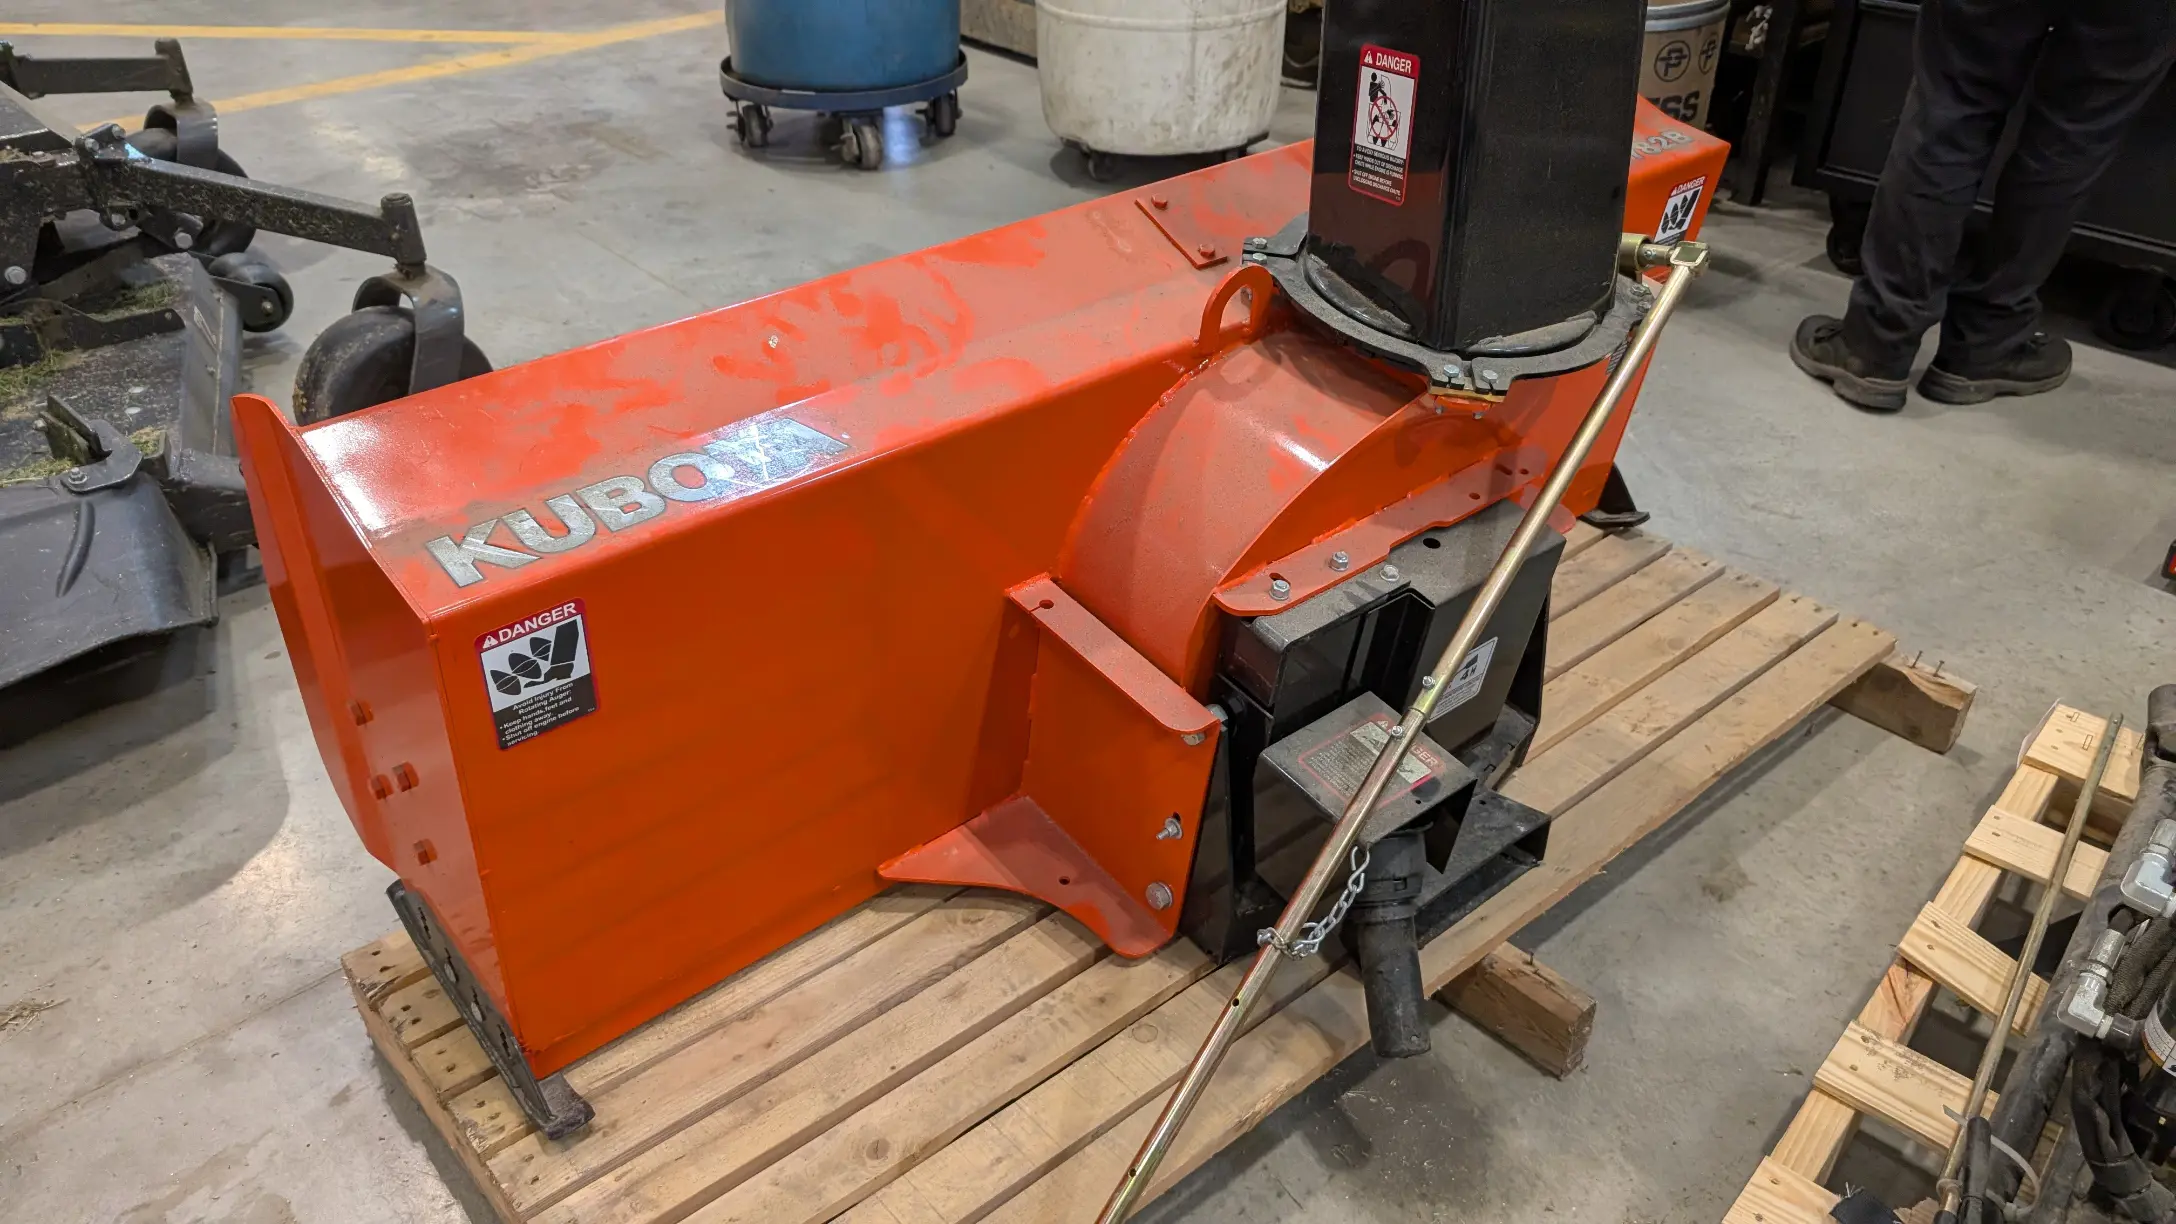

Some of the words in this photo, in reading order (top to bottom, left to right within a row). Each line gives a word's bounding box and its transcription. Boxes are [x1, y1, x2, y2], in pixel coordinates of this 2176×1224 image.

[1376, 53, 1412, 74] DANGER
[1676, 176, 1706, 193] DANGER
[498, 602, 577, 642] DANGER
[513, 699, 533, 711] Avoid
[534, 690, 554, 702] Injury
[555, 682, 574, 693] From
[519, 700, 548, 714] Rotating
[549, 690, 572, 703] Auger:
[504, 719, 522, 729] Keep
[559, 697, 572, 706] and
[505, 720, 532, 735] clothing
[534, 712, 553, 723] away.
[505, 731, 522, 741] Shut
[523, 725, 533, 733] off
[534, 717, 557, 729] engine
[558, 707, 580, 718] before
